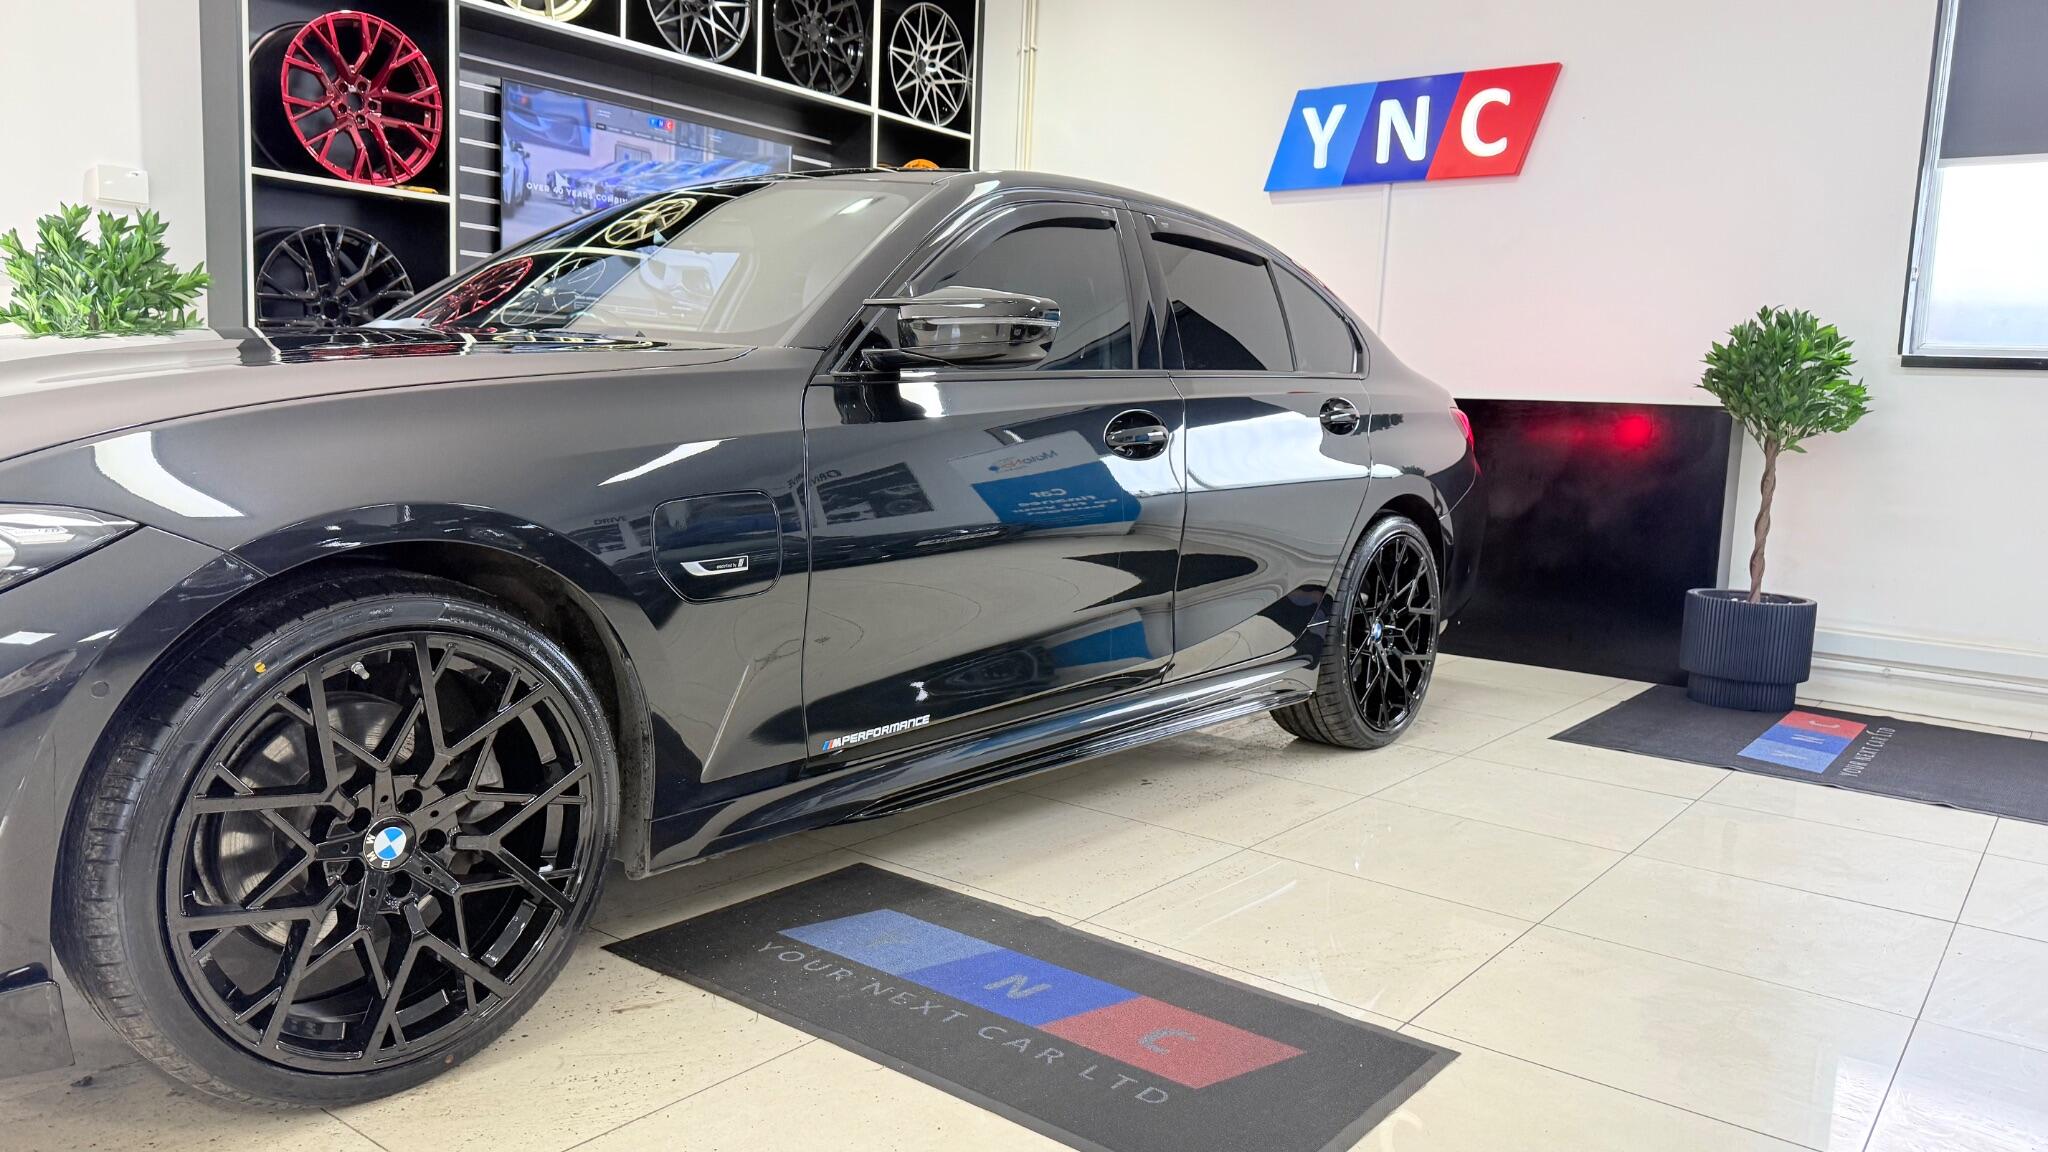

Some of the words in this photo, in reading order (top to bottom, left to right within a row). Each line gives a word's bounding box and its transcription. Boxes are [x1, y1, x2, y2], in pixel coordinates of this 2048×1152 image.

[1302, 88, 1511, 169] YNC
[526, 182, 550, 193] OVER
[566, 187, 593, 200] YEARS
[841, 714, 931, 746] PERFORMANCE
[366, 833, 391, 868] BMW
[758, 941, 853, 982] YOUR
[861, 979, 968, 1023] NEXT
[978, 1026, 1065, 1064] CAR
[1078, 1065, 1169, 1104] LTD
